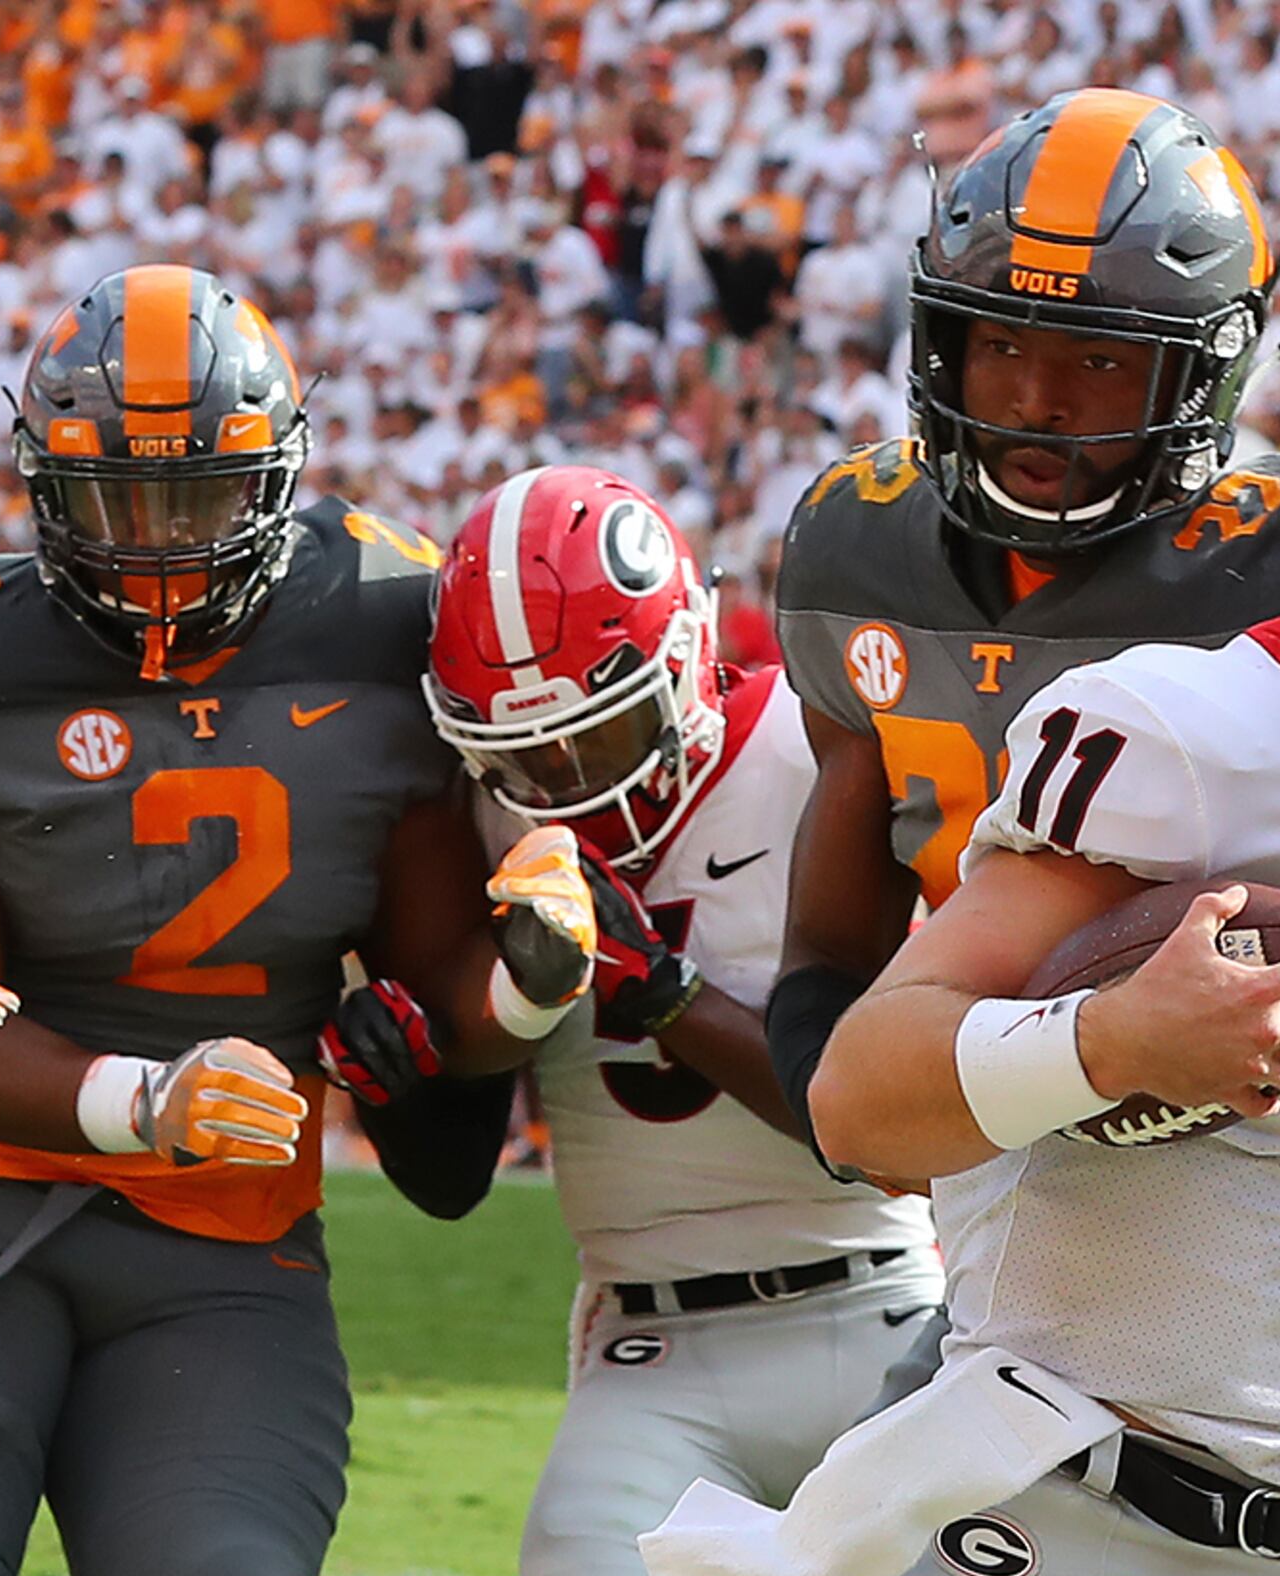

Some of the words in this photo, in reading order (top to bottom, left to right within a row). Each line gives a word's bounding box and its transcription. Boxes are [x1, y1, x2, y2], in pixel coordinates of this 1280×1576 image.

[1010, 269, 1079, 299] VOLS
[129, 437, 188, 458] VOLS
[600, 500, 674, 596] G
[849, 629, 903, 703] SEC
[972, 643, 1014, 693] T
[62, 713, 127, 776] SEC
[180, 699, 220, 739] T
[1017, 706, 1128, 852] 11
[115, 766, 292, 997] 2
[602, 1334, 666, 1367] G
